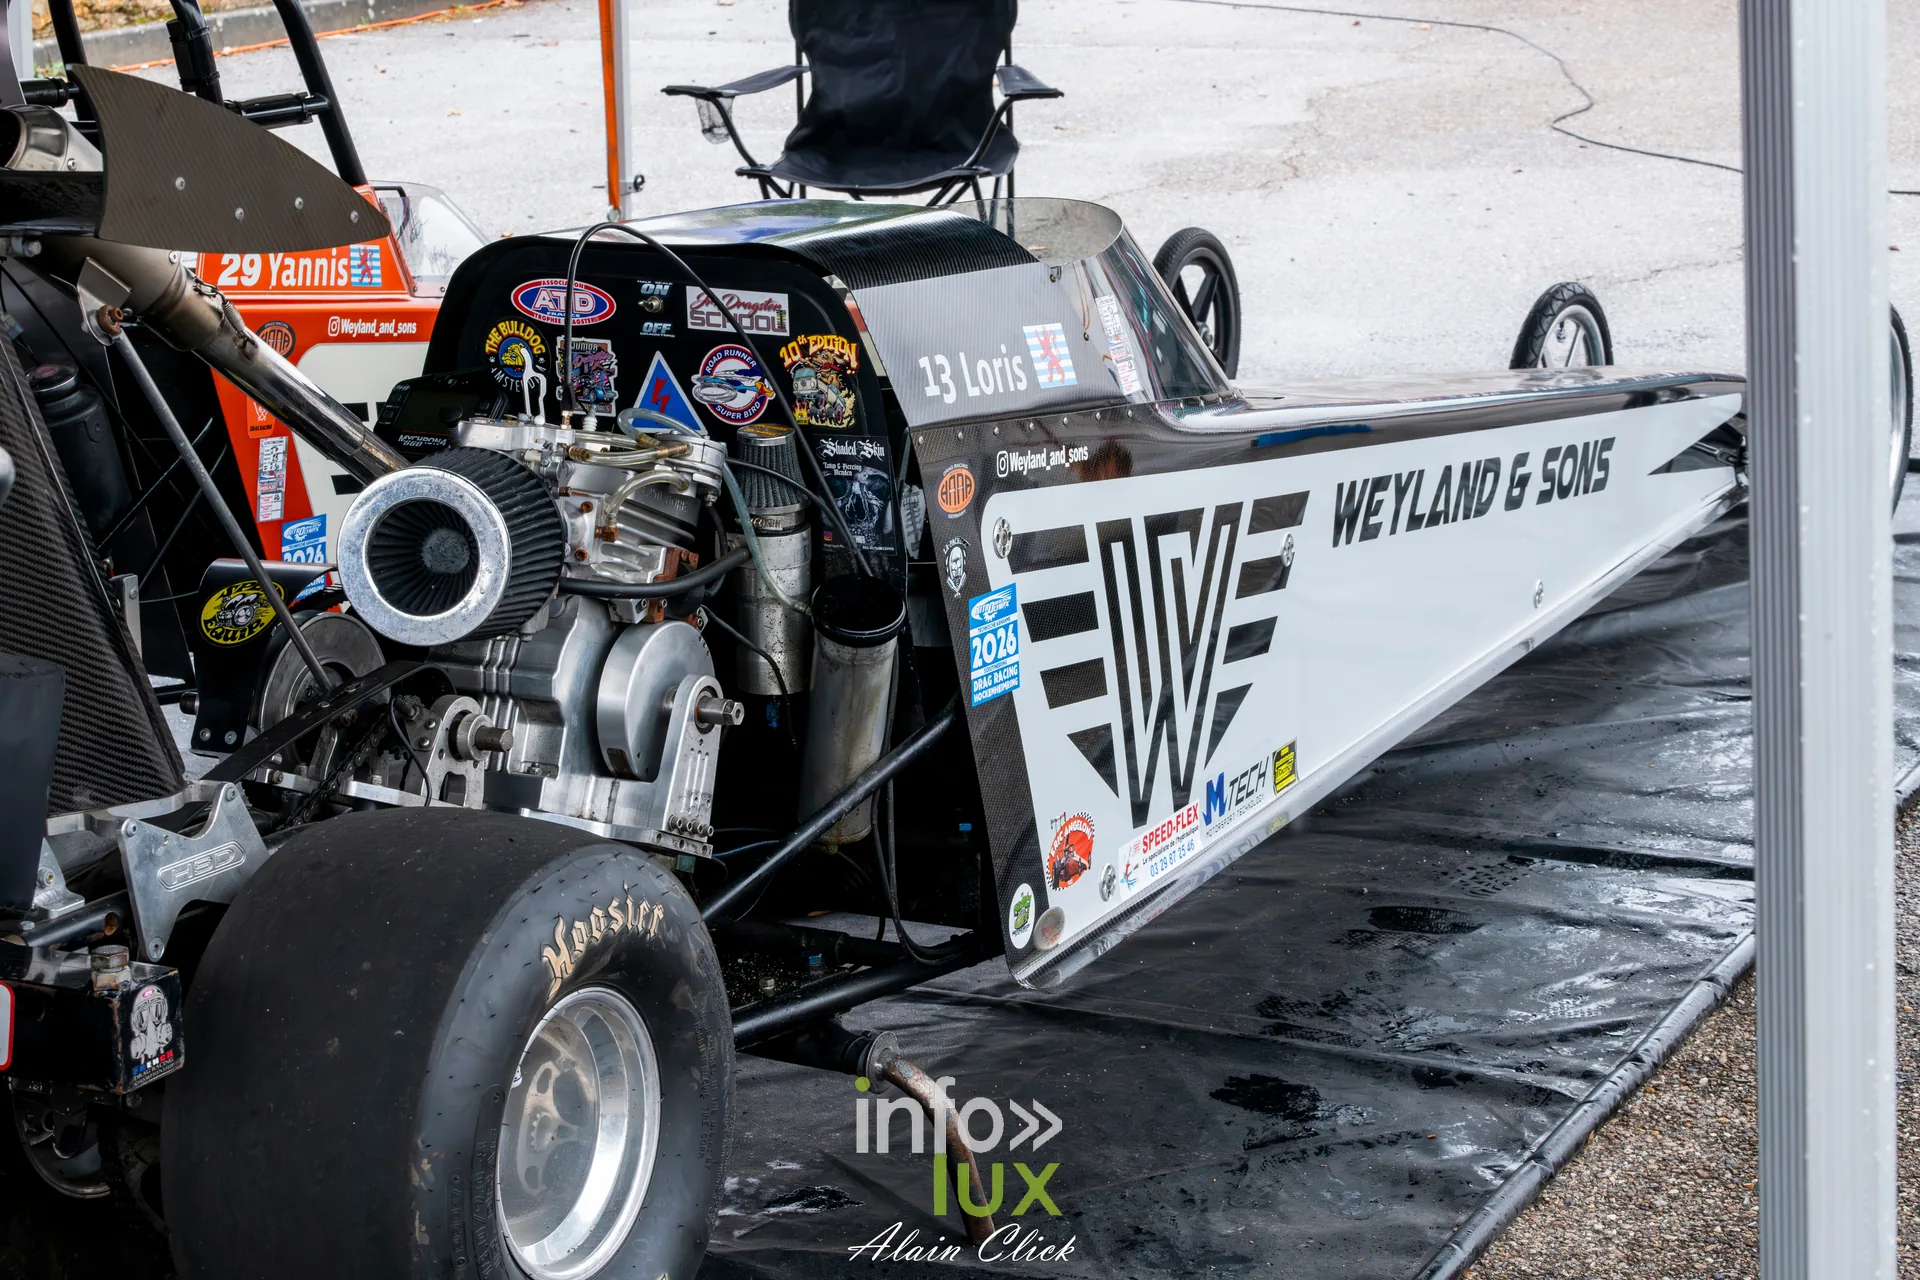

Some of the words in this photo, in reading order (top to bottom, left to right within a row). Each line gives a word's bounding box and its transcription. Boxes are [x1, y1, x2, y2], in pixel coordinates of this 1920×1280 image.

[217, 252, 262, 287] 29
[268, 248, 348, 290] Yannis
[532, 288, 596, 315] ATD
[640, 283, 670, 296] ON
[721, 293, 783, 318] Dragster
[341, 318, 417, 337] Weyland_and_sons
[485, 327, 503, 355] THE
[497, 320, 547, 355] BULLDOG
[643, 321, 672, 334] OFF
[705, 352, 723, 373] ROAD
[724, 349, 757, 367] RUNNER
[918, 353, 957, 404] 13
[959, 343, 1028, 397] Loris
[715, 405, 742, 420] SUPER
[743, 401, 761, 418] BIRD
[857, 439, 885, 461] Skin
[1009, 444, 1089, 477] Weyland_and_sons
[1332, 456, 1501, 549] WEYLAND
[1504, 452, 1533, 512] &
[1536, 437, 1616, 506] SONS
[972, 623, 1017, 669] 2026
[973, 674, 993, 693] DRAG
[993, 664, 1018, 685] RACING
[973, 677, 1019, 703] HOCKENHEIMRING
[1051, 831, 1064, 858] ERIC
[1064, 820, 1092, 841] ANGELONI
[1142, 802, 1199, 854] SPEED-FLEX
[1150, 862, 1159, 877] 03
[1160, 857, 1168, 872] 29
[1169, 850, 1176, 865] 87
[1177, 844, 1187, 859] 25
[1187, 839, 1195, 852] 46
[540, 880, 664, 1003] Hoosier
[132, 1050, 174, 1076] FRENCH
[151, 1058, 174, 1073] RACING
